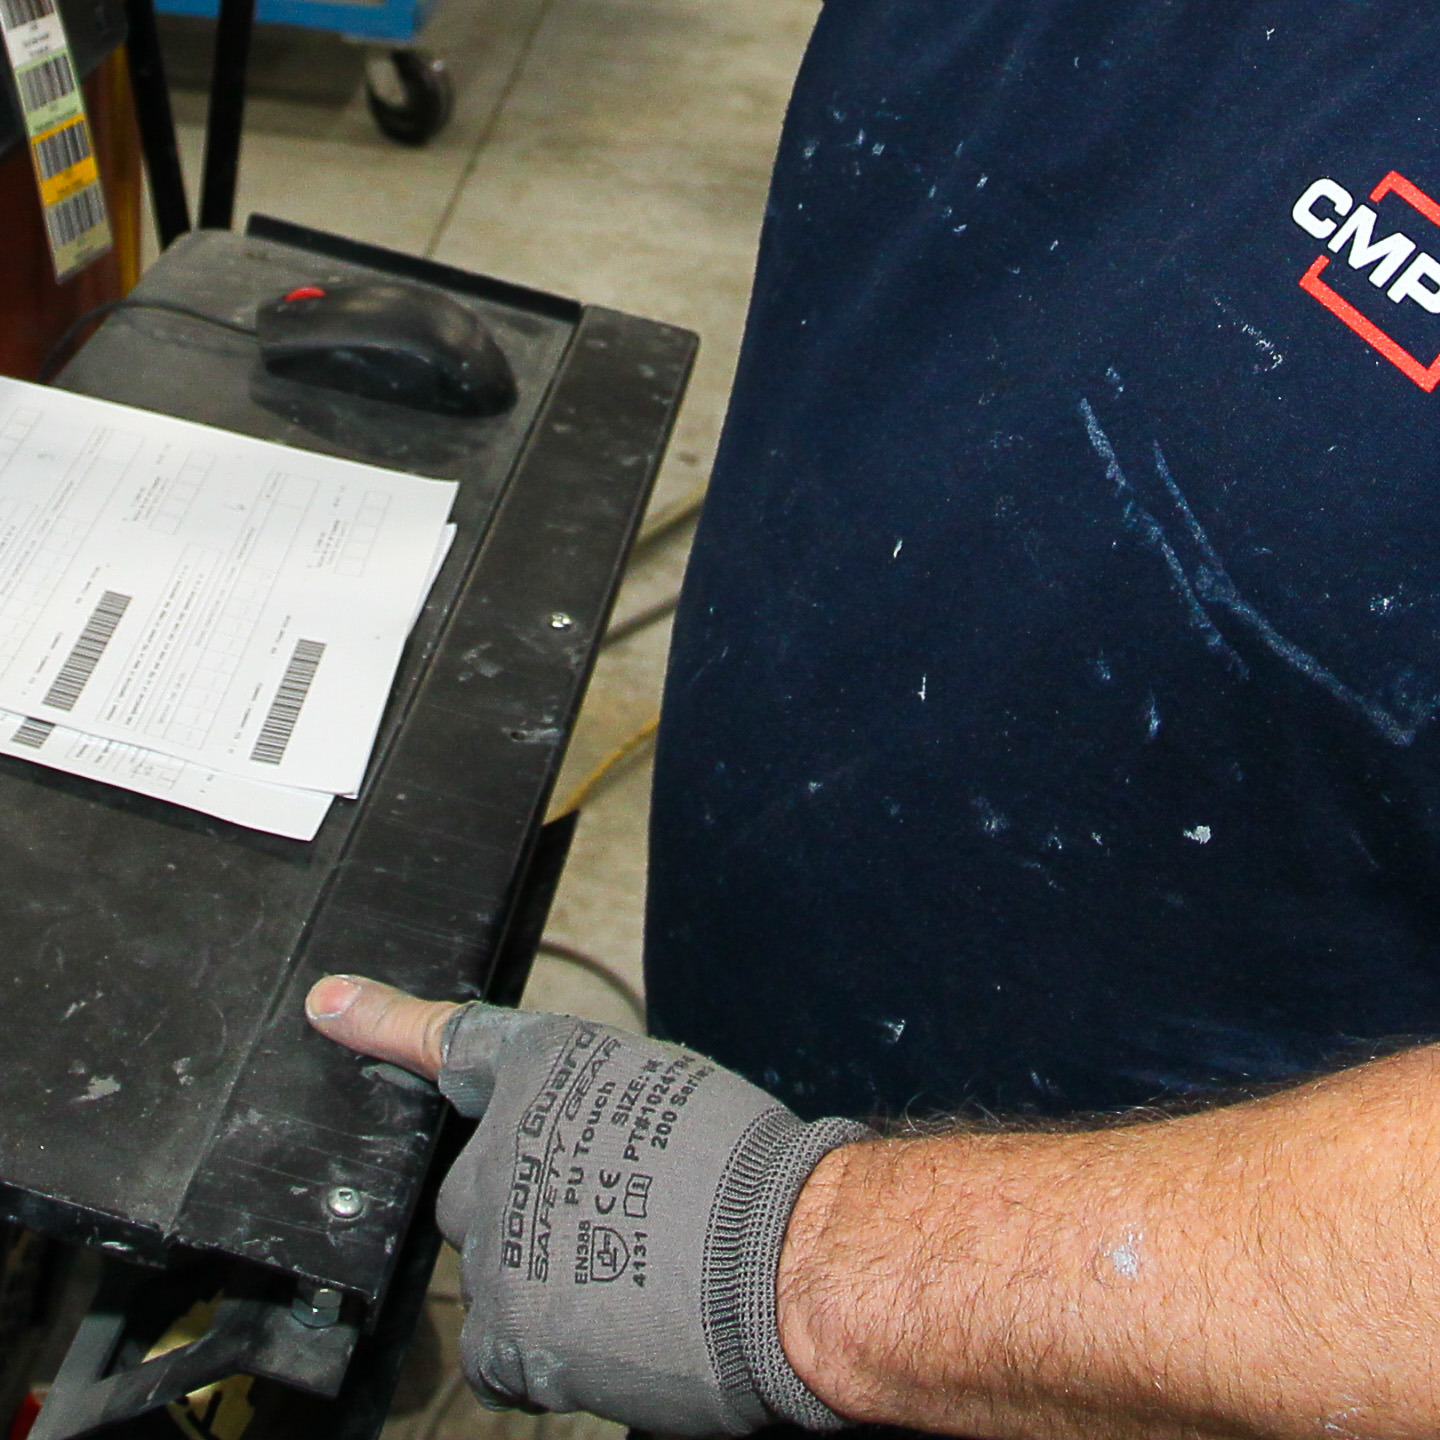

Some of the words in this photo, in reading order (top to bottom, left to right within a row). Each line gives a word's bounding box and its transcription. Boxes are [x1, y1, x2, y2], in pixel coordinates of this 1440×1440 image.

[522, 1022, 599, 1139] Guard
[611, 1074, 651, 1126] SIZE:
[573, 1080, 617, 1158] Touch
[651, 1111, 678, 1150] 200
[534, 1128, 566, 1283] SAFETY
[565, 1039, 622, 1121] GEAR
[564, 1166, 585, 1205] PU
[503, 1153, 542, 1269] Body
[575, 1220, 591, 1285] EN388
[632, 1231, 649, 1288] 4131
